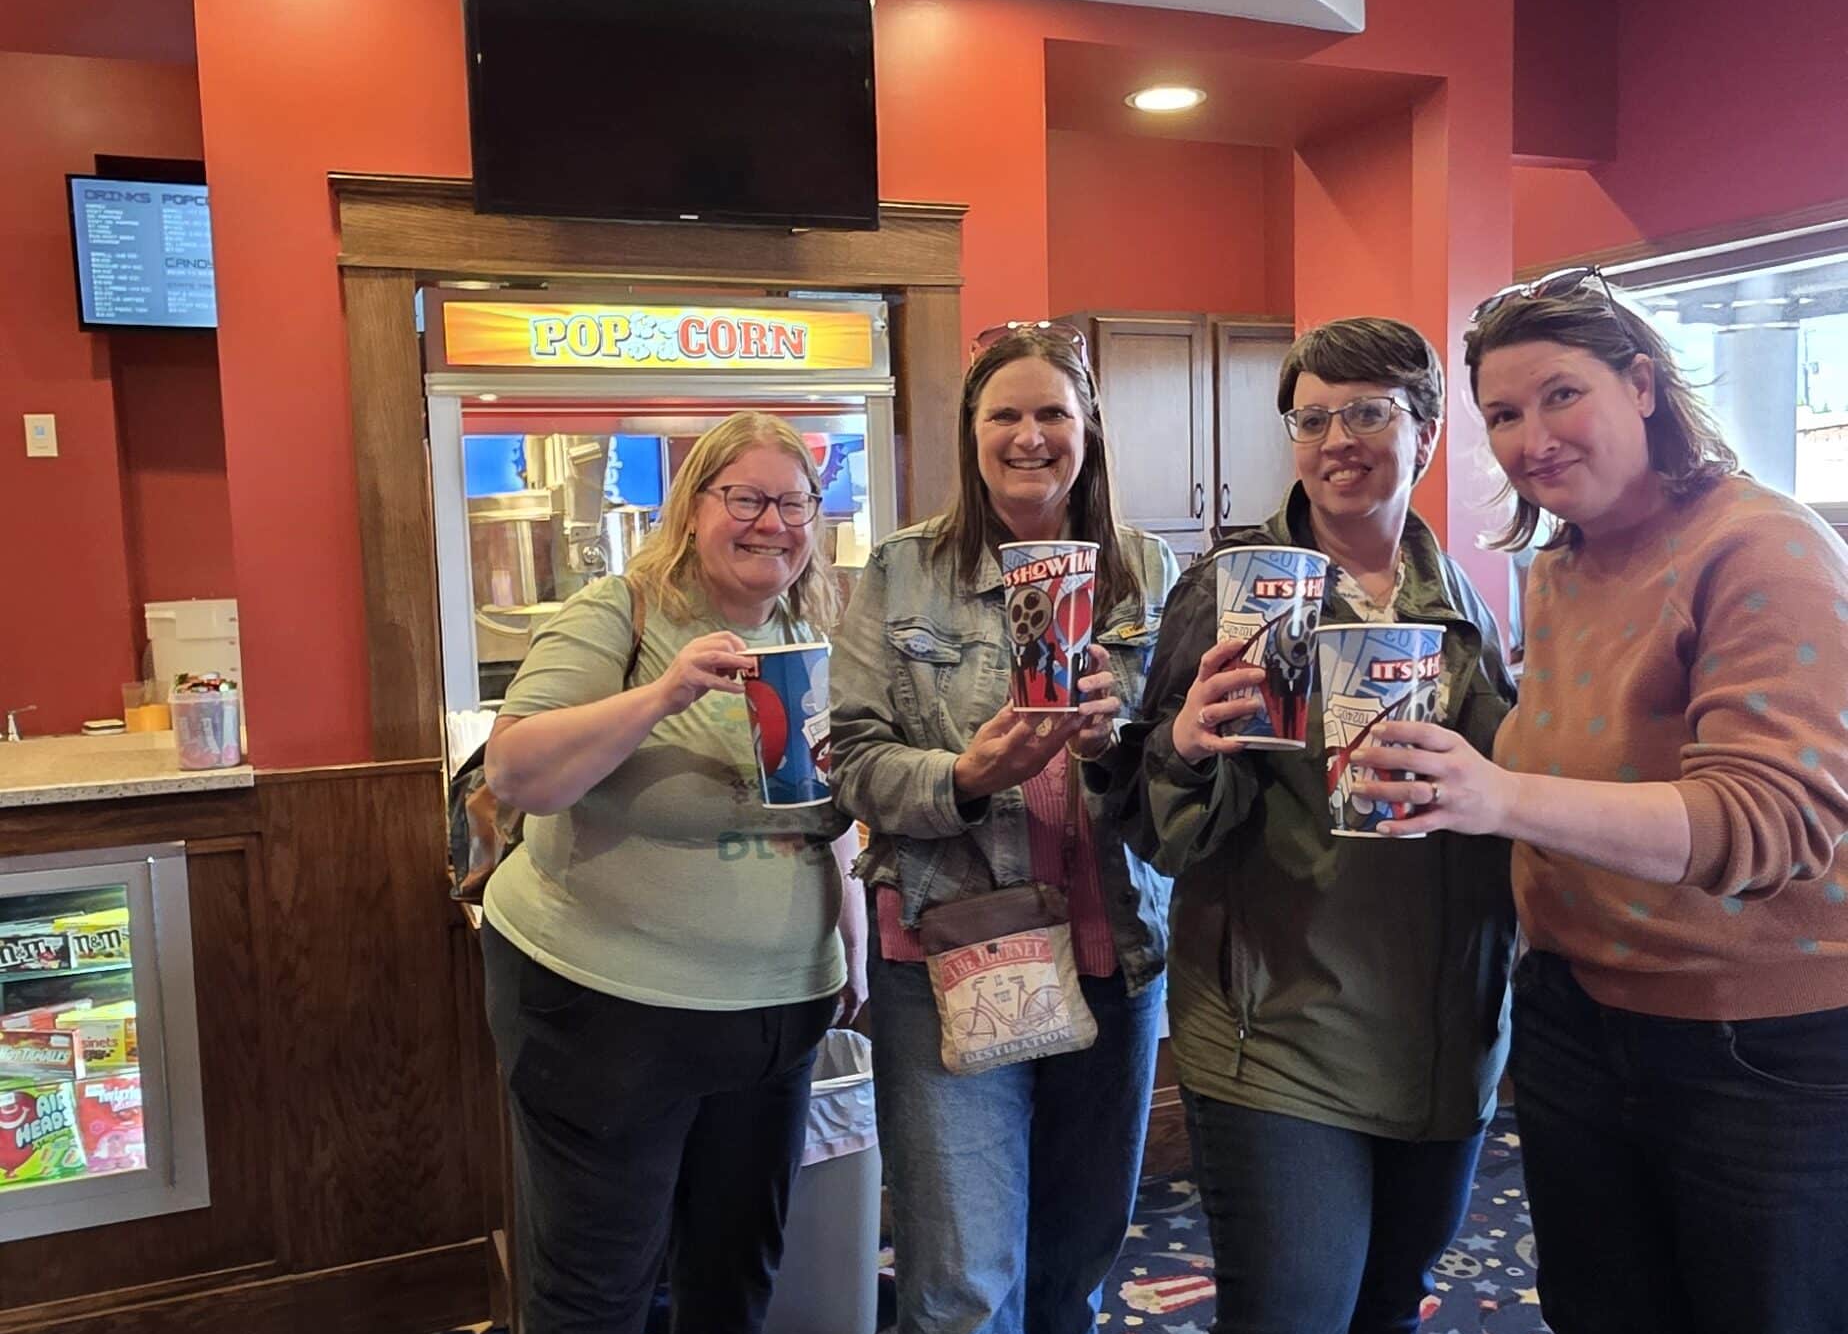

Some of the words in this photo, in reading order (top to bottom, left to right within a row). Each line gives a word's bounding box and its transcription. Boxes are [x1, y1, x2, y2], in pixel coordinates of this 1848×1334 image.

[84, 189, 151, 203] DRINKS
[1255, 580, 1294, 597] IT'S
[1371, 661, 1412, 680] IT'S
[943, 954, 977, 980] THE
[964, 1028, 1072, 1064] DESTINATION
